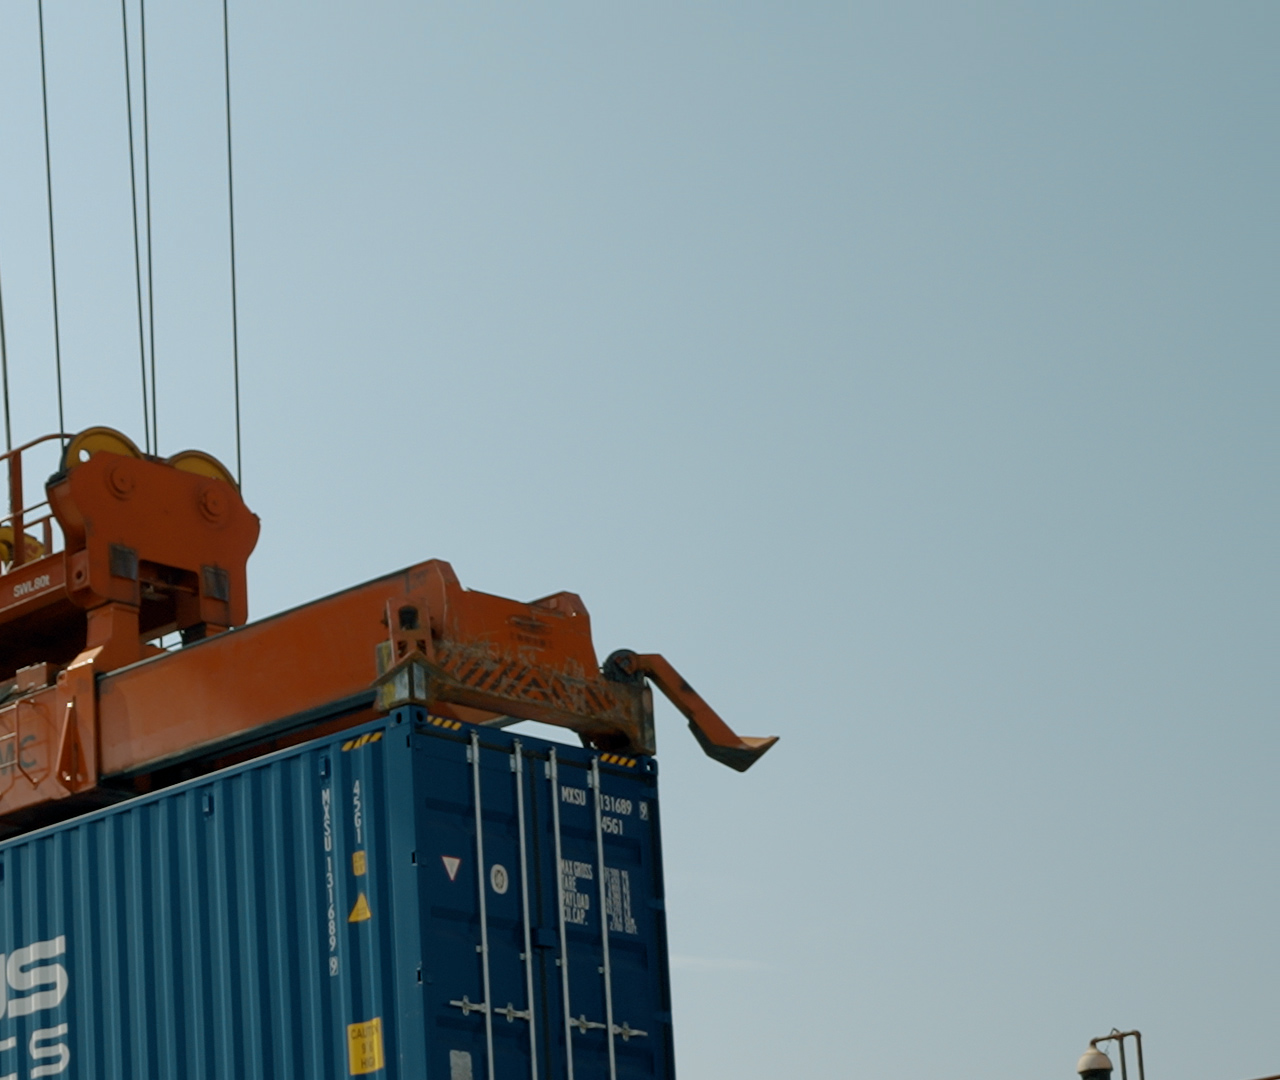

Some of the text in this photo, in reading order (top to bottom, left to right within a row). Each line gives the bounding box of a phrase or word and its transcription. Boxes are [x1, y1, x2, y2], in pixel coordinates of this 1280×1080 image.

[321, 788, 332, 851] MXSU
[353, 780, 362, 844] 45G1
[561, 785, 586, 807] MXSU
[326, 857, 336, 951] 131689
